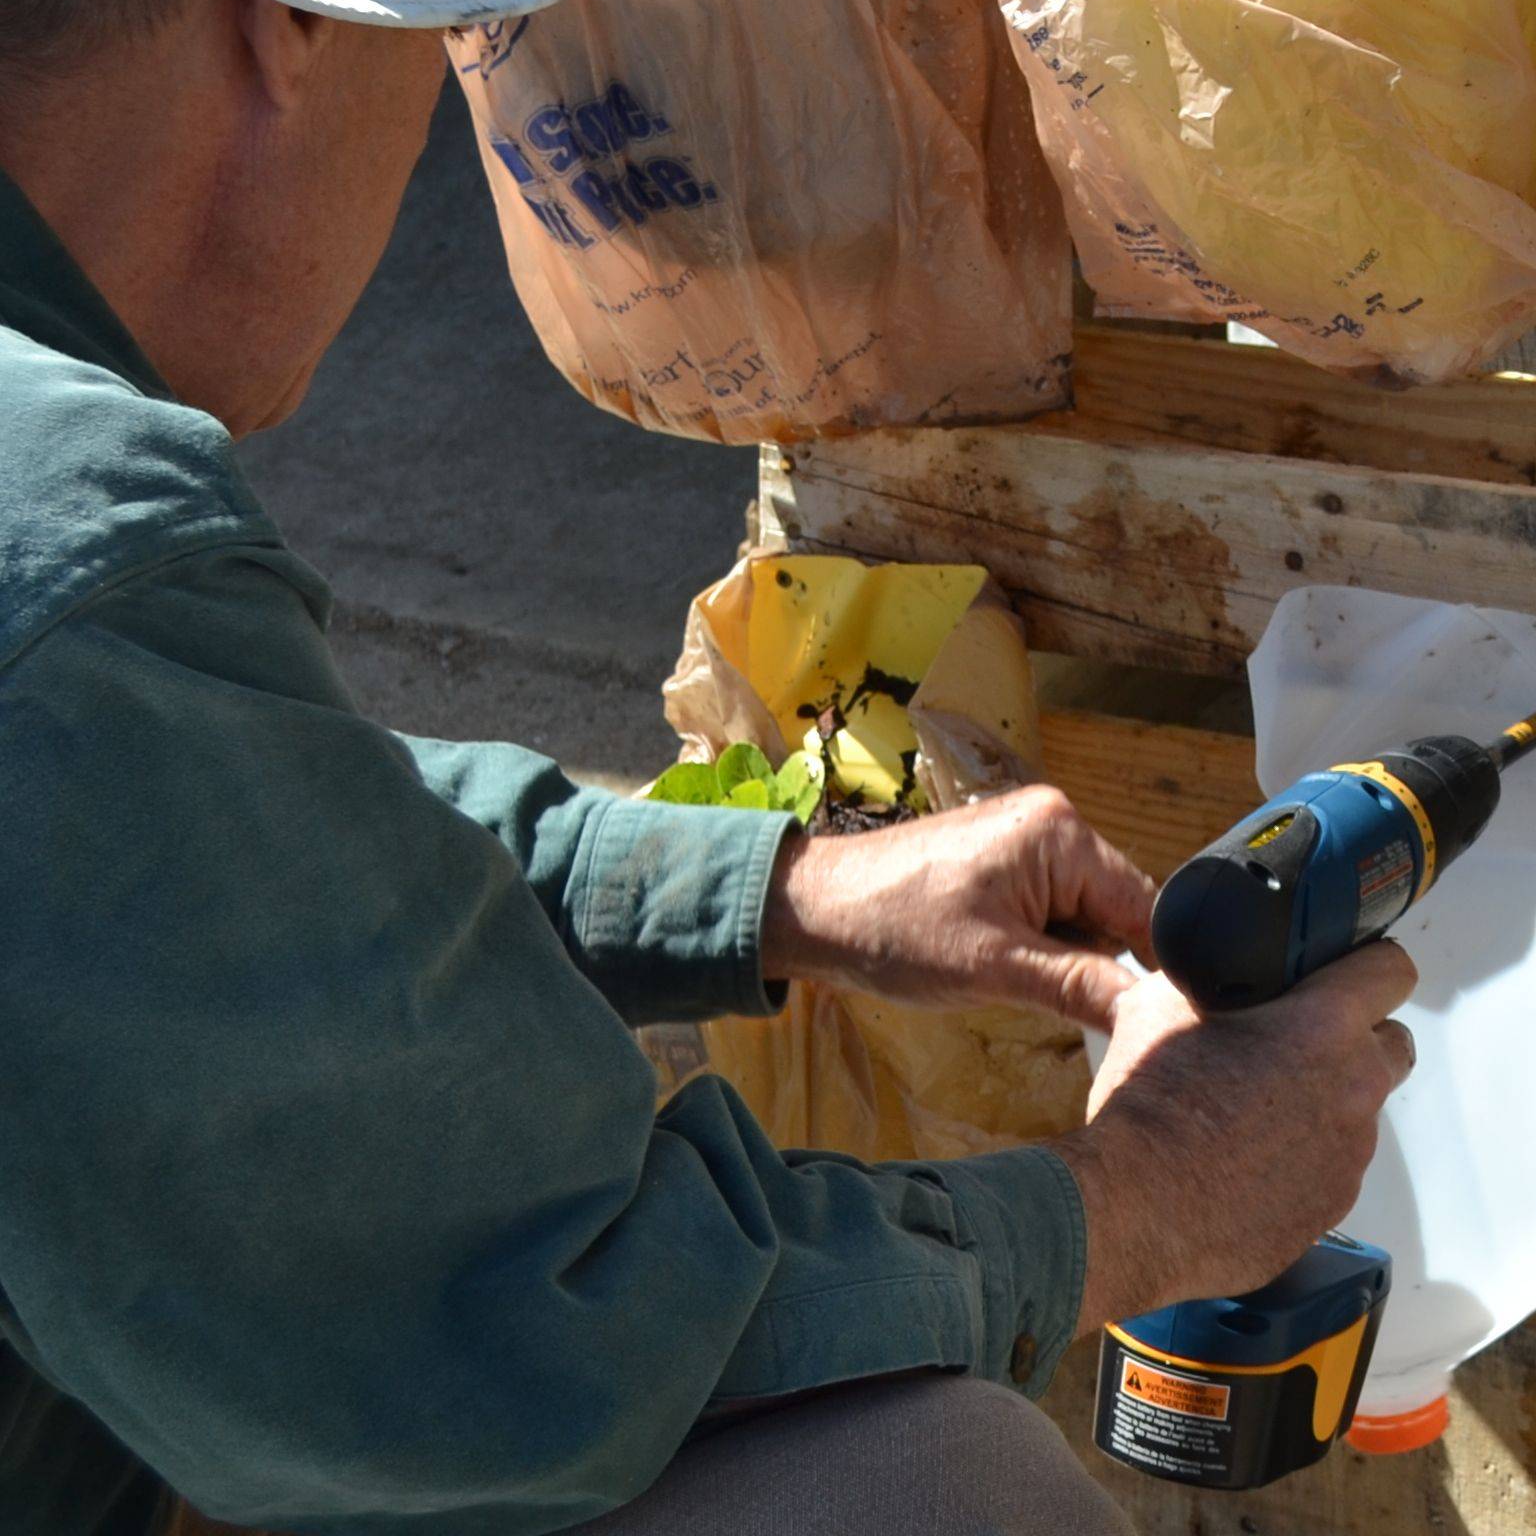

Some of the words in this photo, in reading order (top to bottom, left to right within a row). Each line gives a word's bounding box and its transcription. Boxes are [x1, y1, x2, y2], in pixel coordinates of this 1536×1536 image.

[1145, 1382, 1223, 1407] AVERTISSEMENT
[1161, 1376, 1206, 1394] WARNING
[1148, 1393, 1216, 1416] ADVERTENCIA
